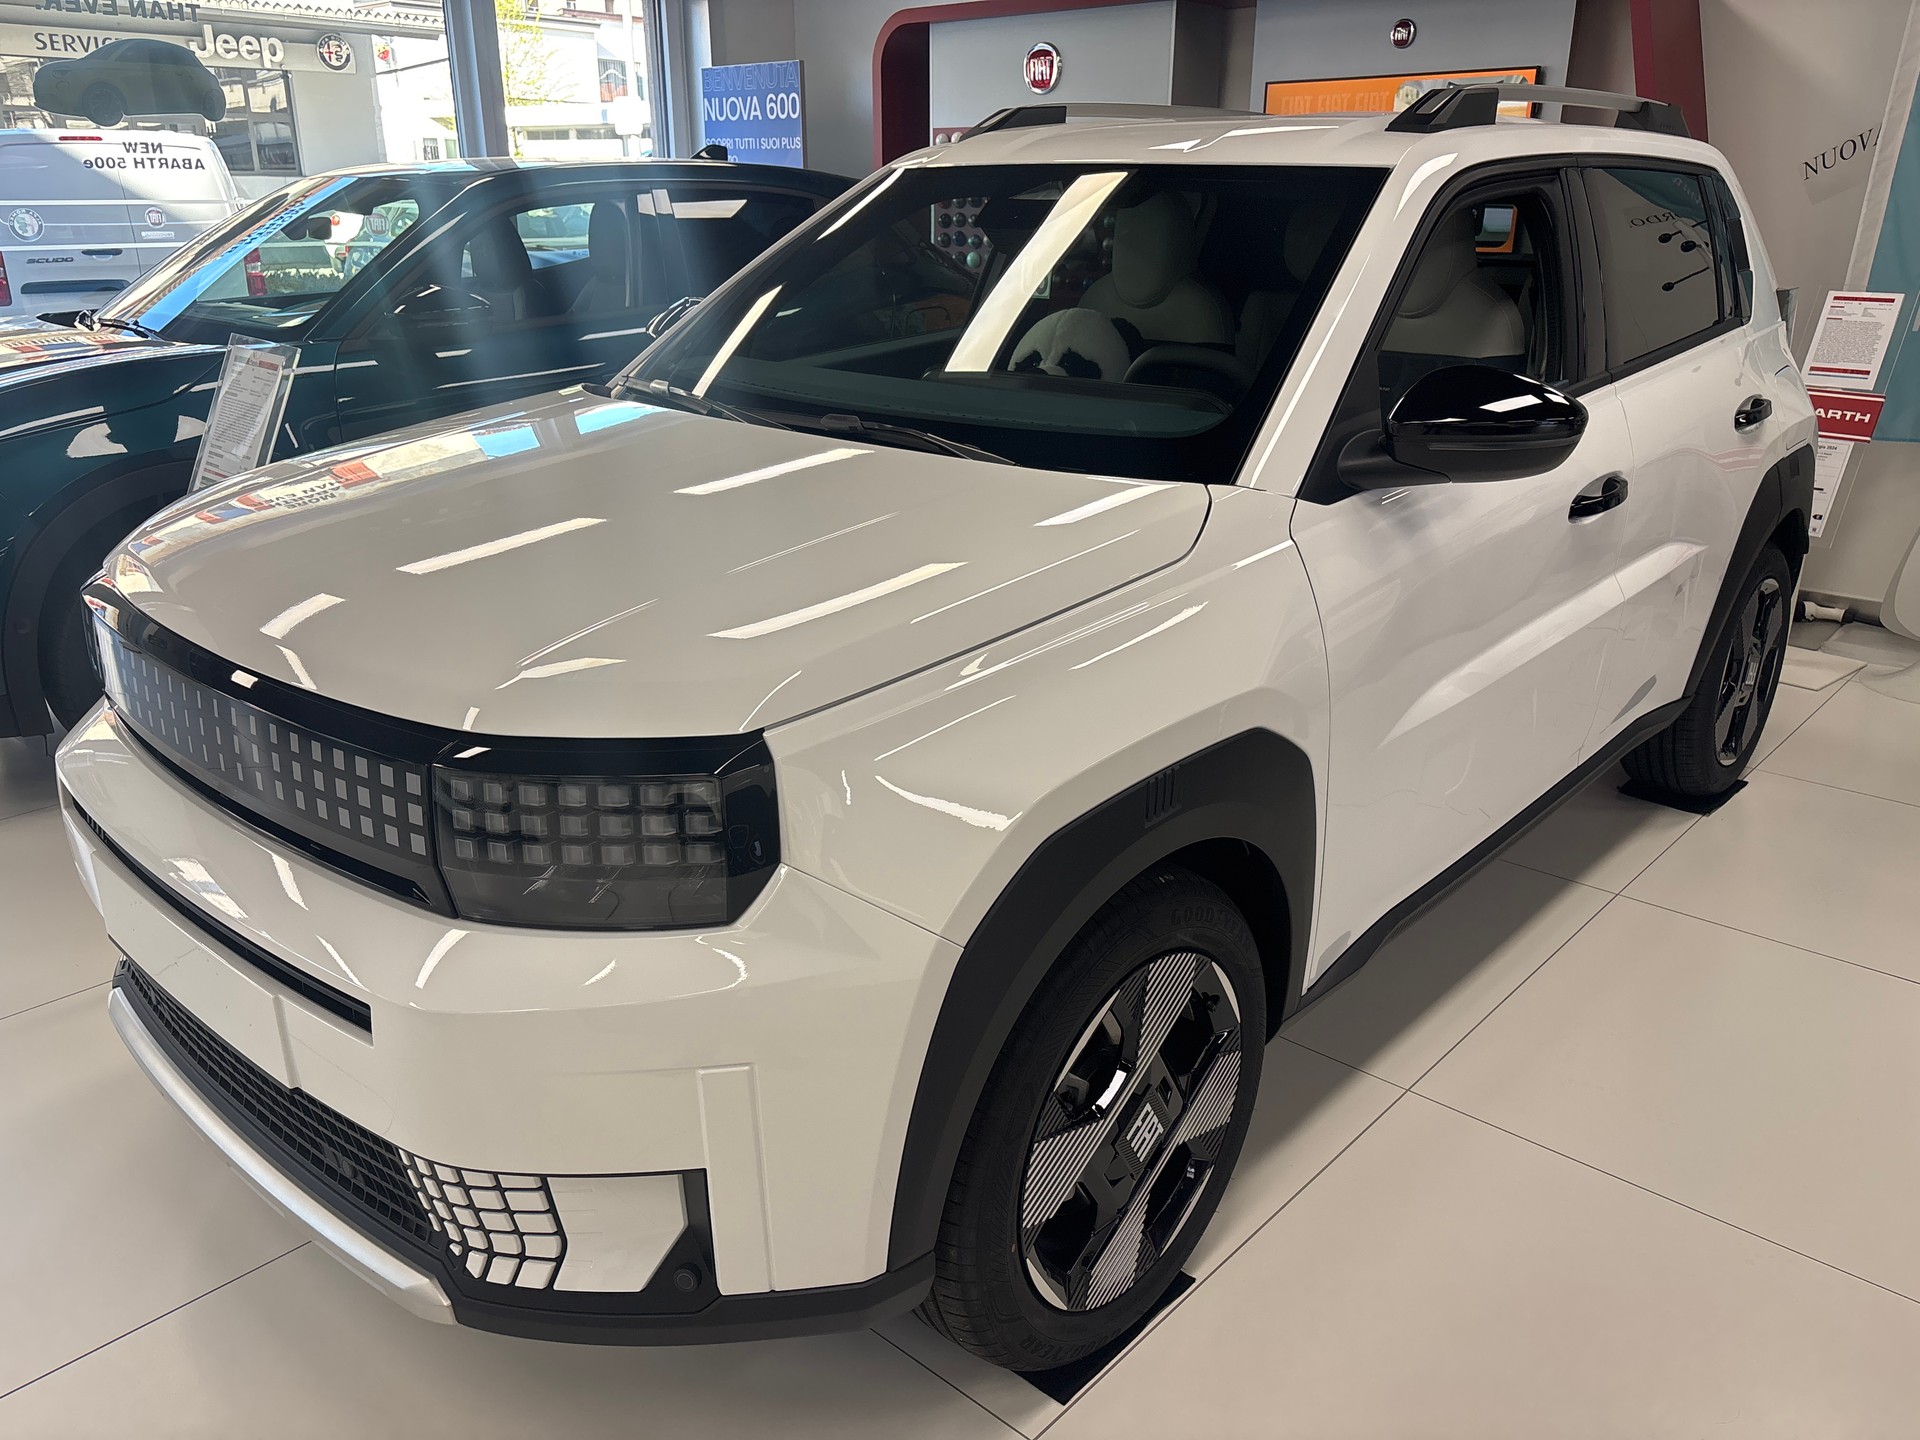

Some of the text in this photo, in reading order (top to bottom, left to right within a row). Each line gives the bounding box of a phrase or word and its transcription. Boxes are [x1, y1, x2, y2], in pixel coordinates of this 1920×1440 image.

[189, 24, 285, 69] Jeep
[1030, 56, 1053, 81] FIAT
[703, 92, 800, 122] NUOVA 600
[781, 136, 801, 149] PLUS
[1126, 1102, 1164, 1163] FIAT
